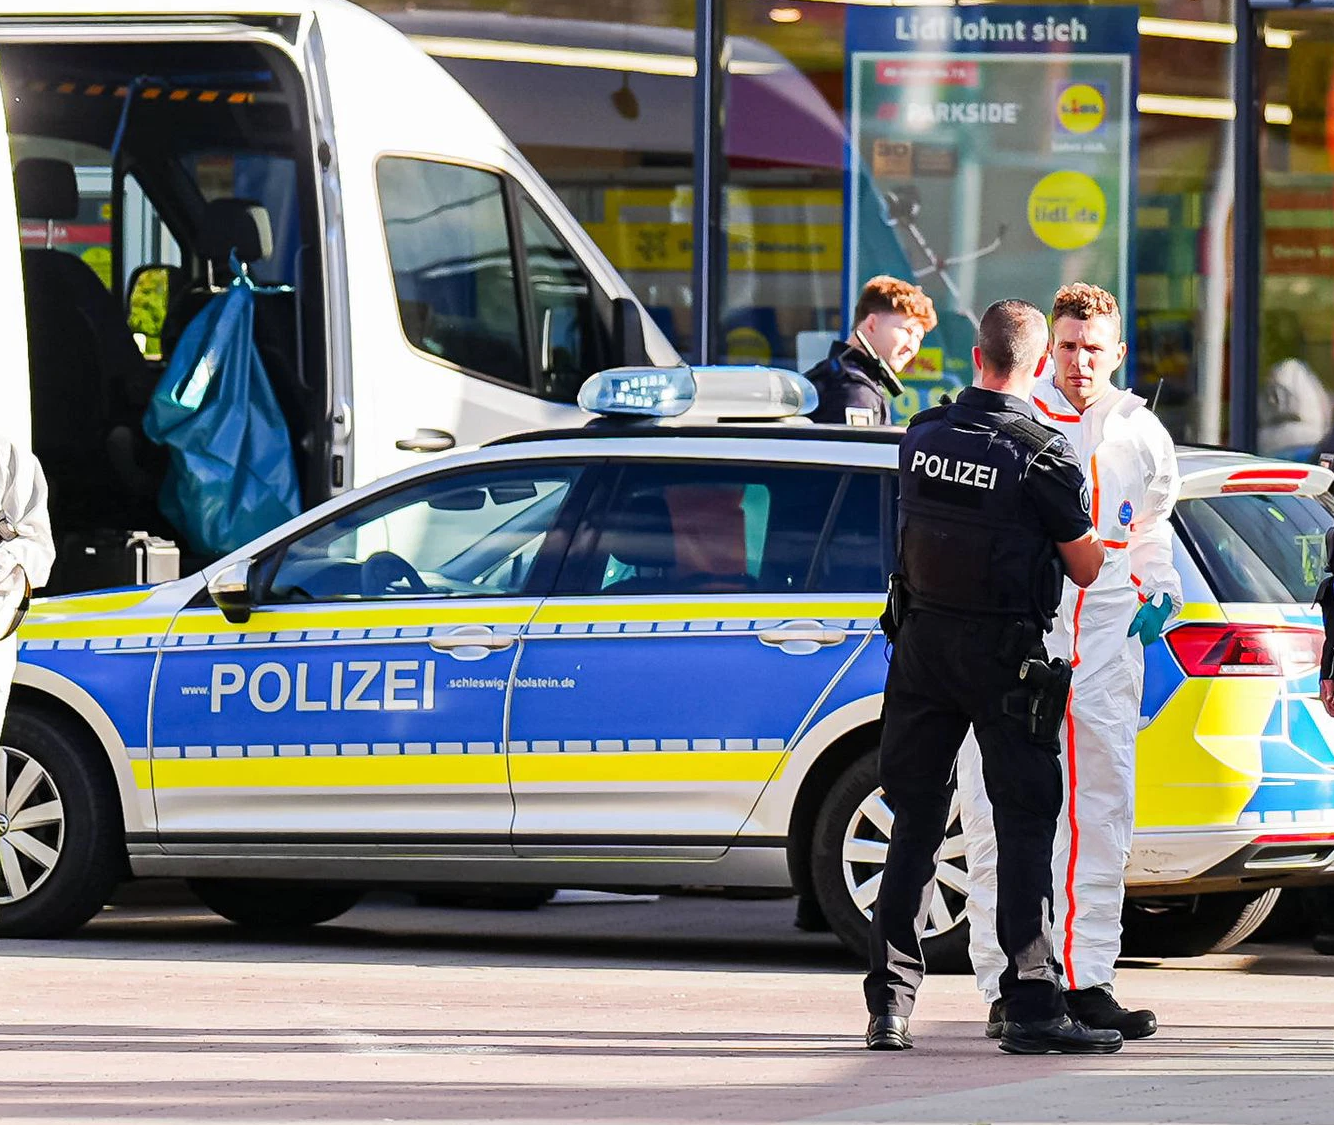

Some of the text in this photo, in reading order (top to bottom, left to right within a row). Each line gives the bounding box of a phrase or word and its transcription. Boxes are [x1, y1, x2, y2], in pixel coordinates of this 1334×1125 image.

[895, 17, 1087, 41] Lidl lohnt sich
[906, 103, 1017, 124] PARKSIDE
[910, 450, 998, 490] POLIZEI
[210, 660, 436, 713] POLIZEI
